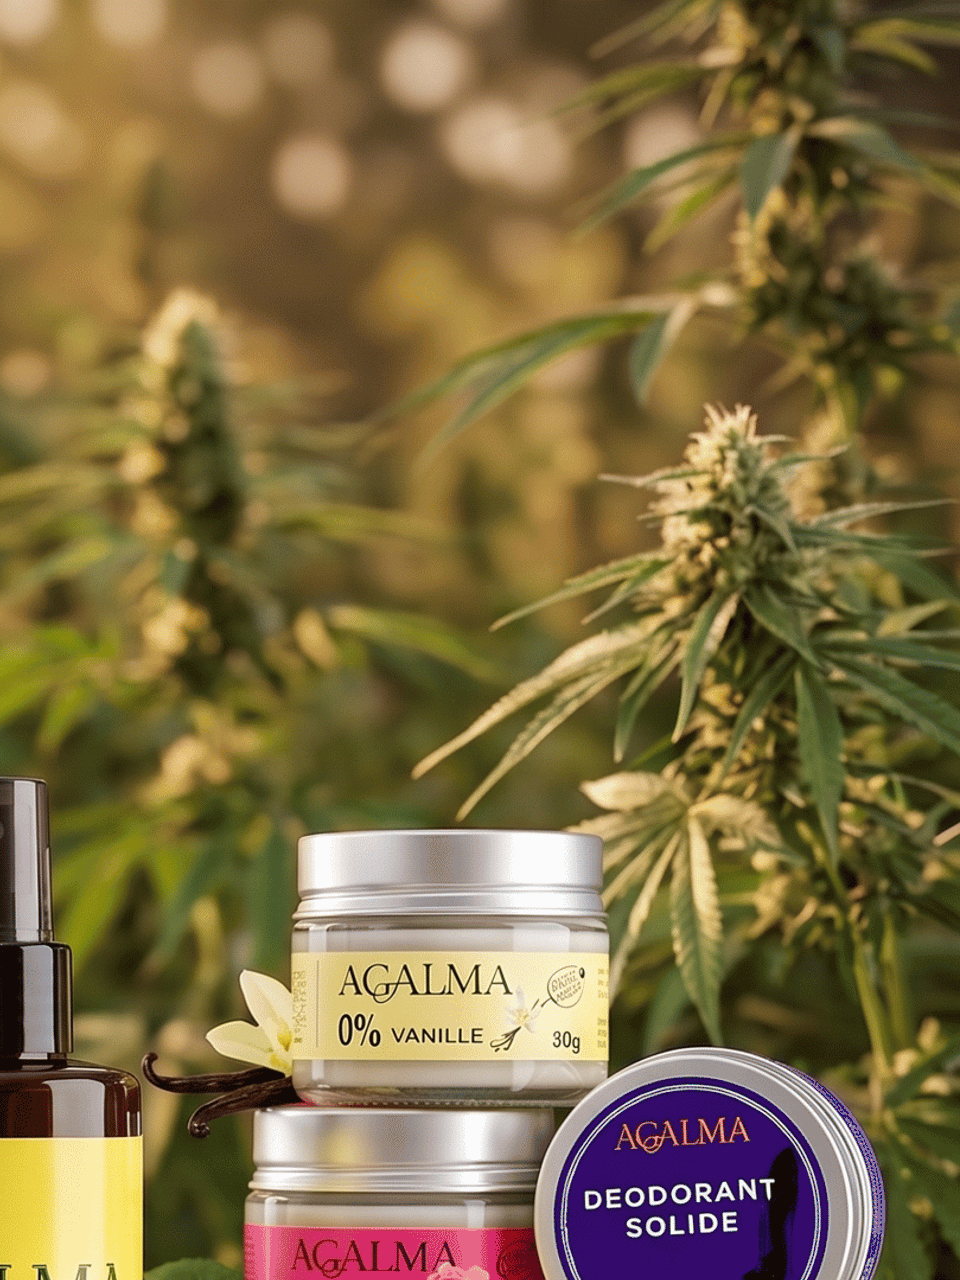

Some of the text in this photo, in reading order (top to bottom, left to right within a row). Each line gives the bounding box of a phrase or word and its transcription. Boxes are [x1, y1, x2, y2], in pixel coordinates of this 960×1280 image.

[338, 963, 513, 1004] AGALMA
[338, 1013, 484, 1047] 0% VANILLE
[552, 1030, 580, 1054] 30g
[614, 1116, 751, 1154] AGALMA
[584, 1178, 776, 1210] DEODORANT
[626, 1211, 739, 1238] SOLIDE
[291, 1238, 457, 1279] AGALMA
